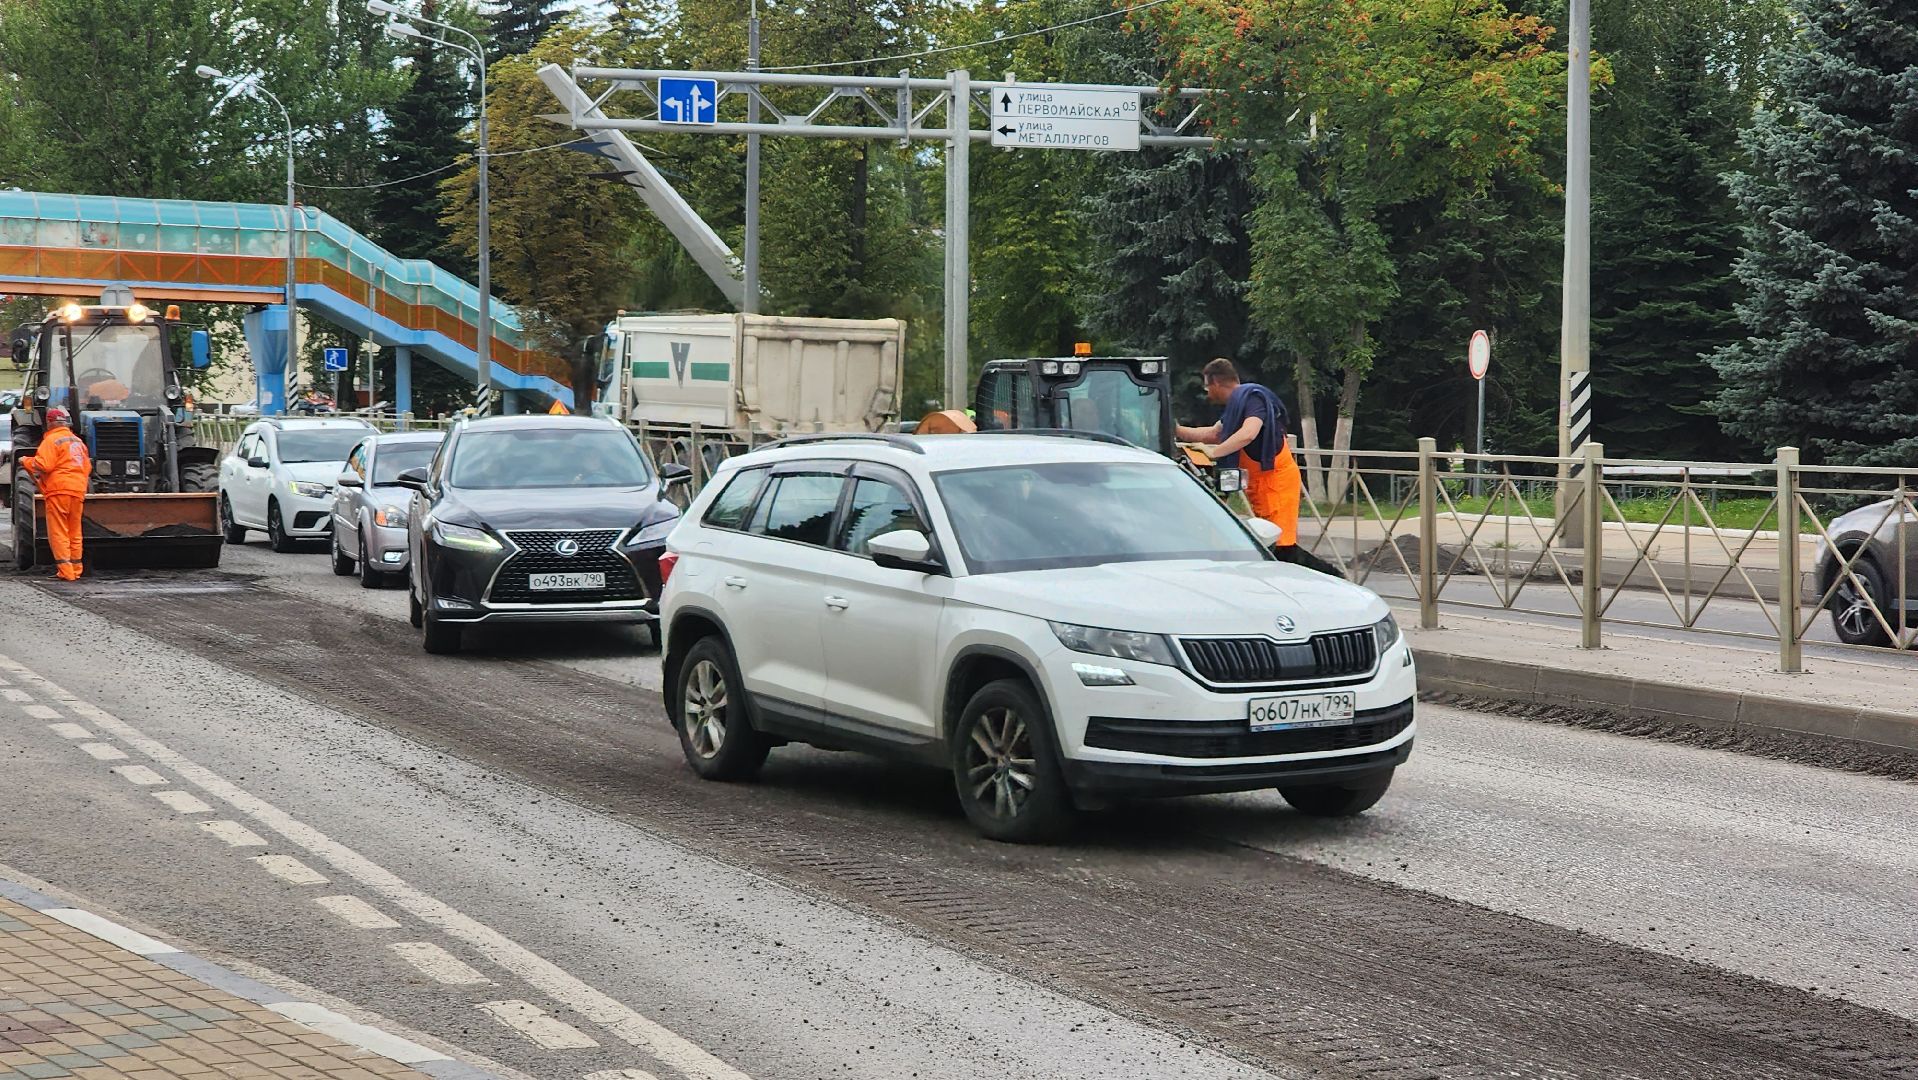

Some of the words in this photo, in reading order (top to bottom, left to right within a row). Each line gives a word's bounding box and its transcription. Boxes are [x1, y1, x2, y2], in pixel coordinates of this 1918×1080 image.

[1019, 93, 1053, 103] улица
[1018, 103, 1120, 118] ПЕРВОМАЙСКАЯ
[1018, 121, 1053, 131] улица
[1018, 132, 1109, 146] МЕТАЛЛУРГОВ
[534, 575, 580, 587] О493ВК
[584, 573, 602, 582] 790
[1256, 700, 1321, 721] О607НК
[1324, 695, 1349, 711] 799
